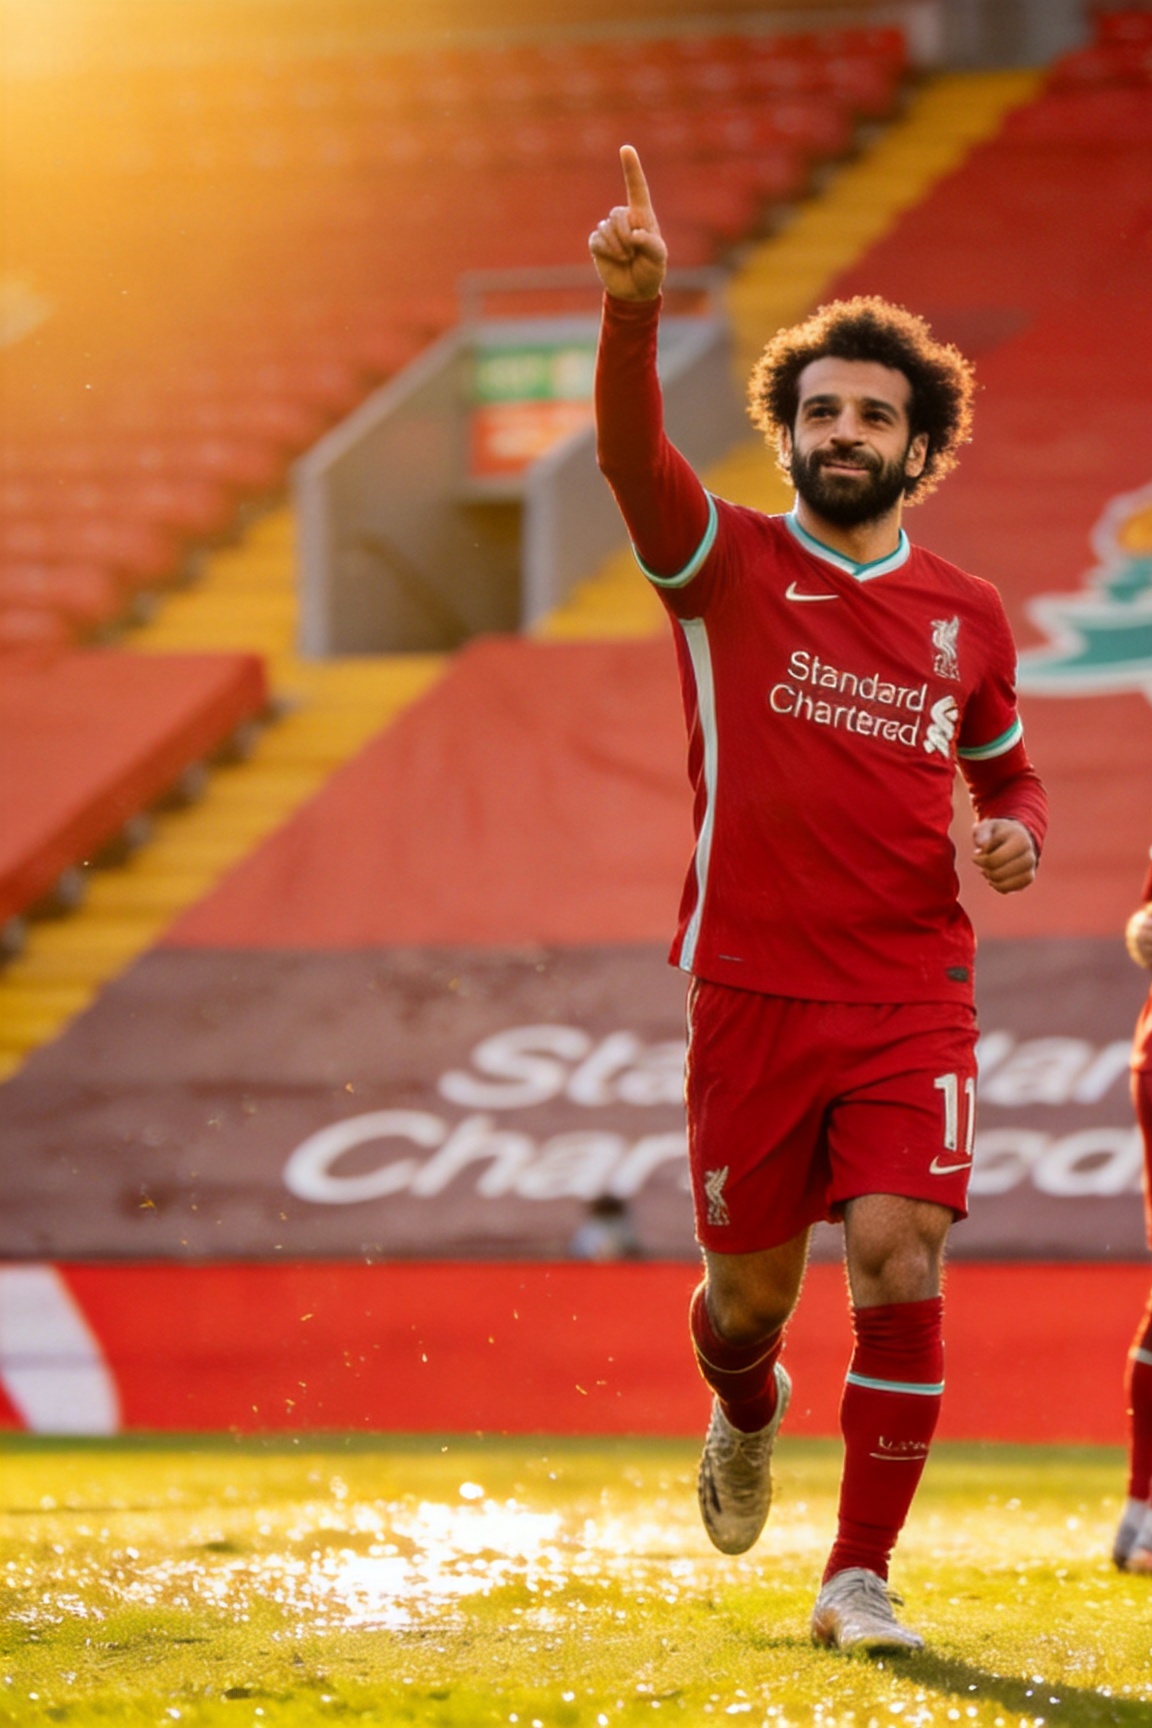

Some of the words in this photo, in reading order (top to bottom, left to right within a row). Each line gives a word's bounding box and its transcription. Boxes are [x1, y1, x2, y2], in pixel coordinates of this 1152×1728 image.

[787, 650, 928, 712] Standard
[768, 683, 921, 747] Chartered
[933, 1072, 975, 1156] 11
